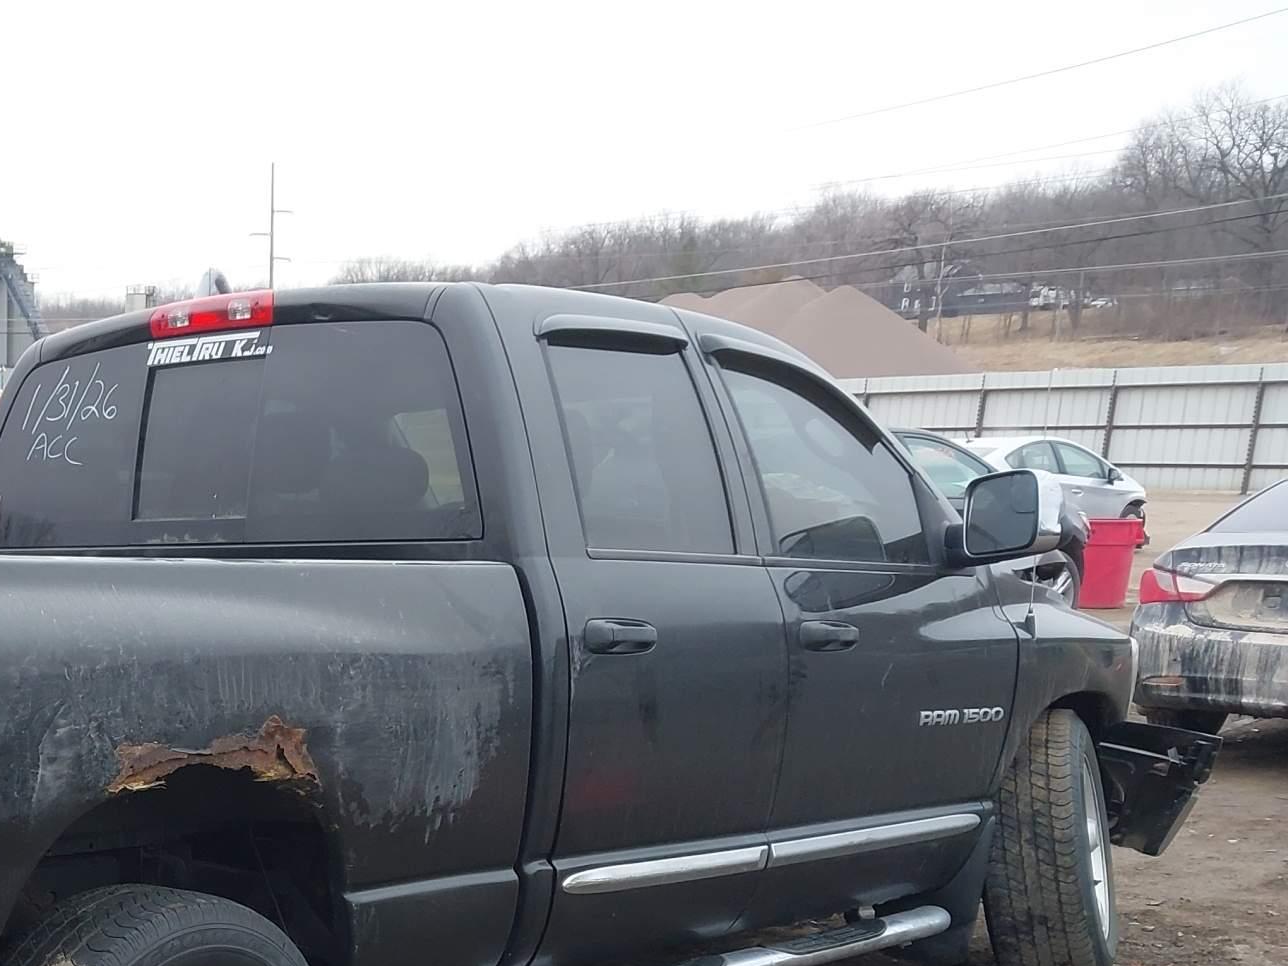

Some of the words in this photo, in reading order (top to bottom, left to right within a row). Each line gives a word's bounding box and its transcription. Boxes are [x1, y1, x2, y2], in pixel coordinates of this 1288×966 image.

[22, 362, 118, 434] 1/31/26
[26, 432, 83, 465] ACC
[919, 709, 960, 726] RAM
[962, 706, 1004, 724] 1500
